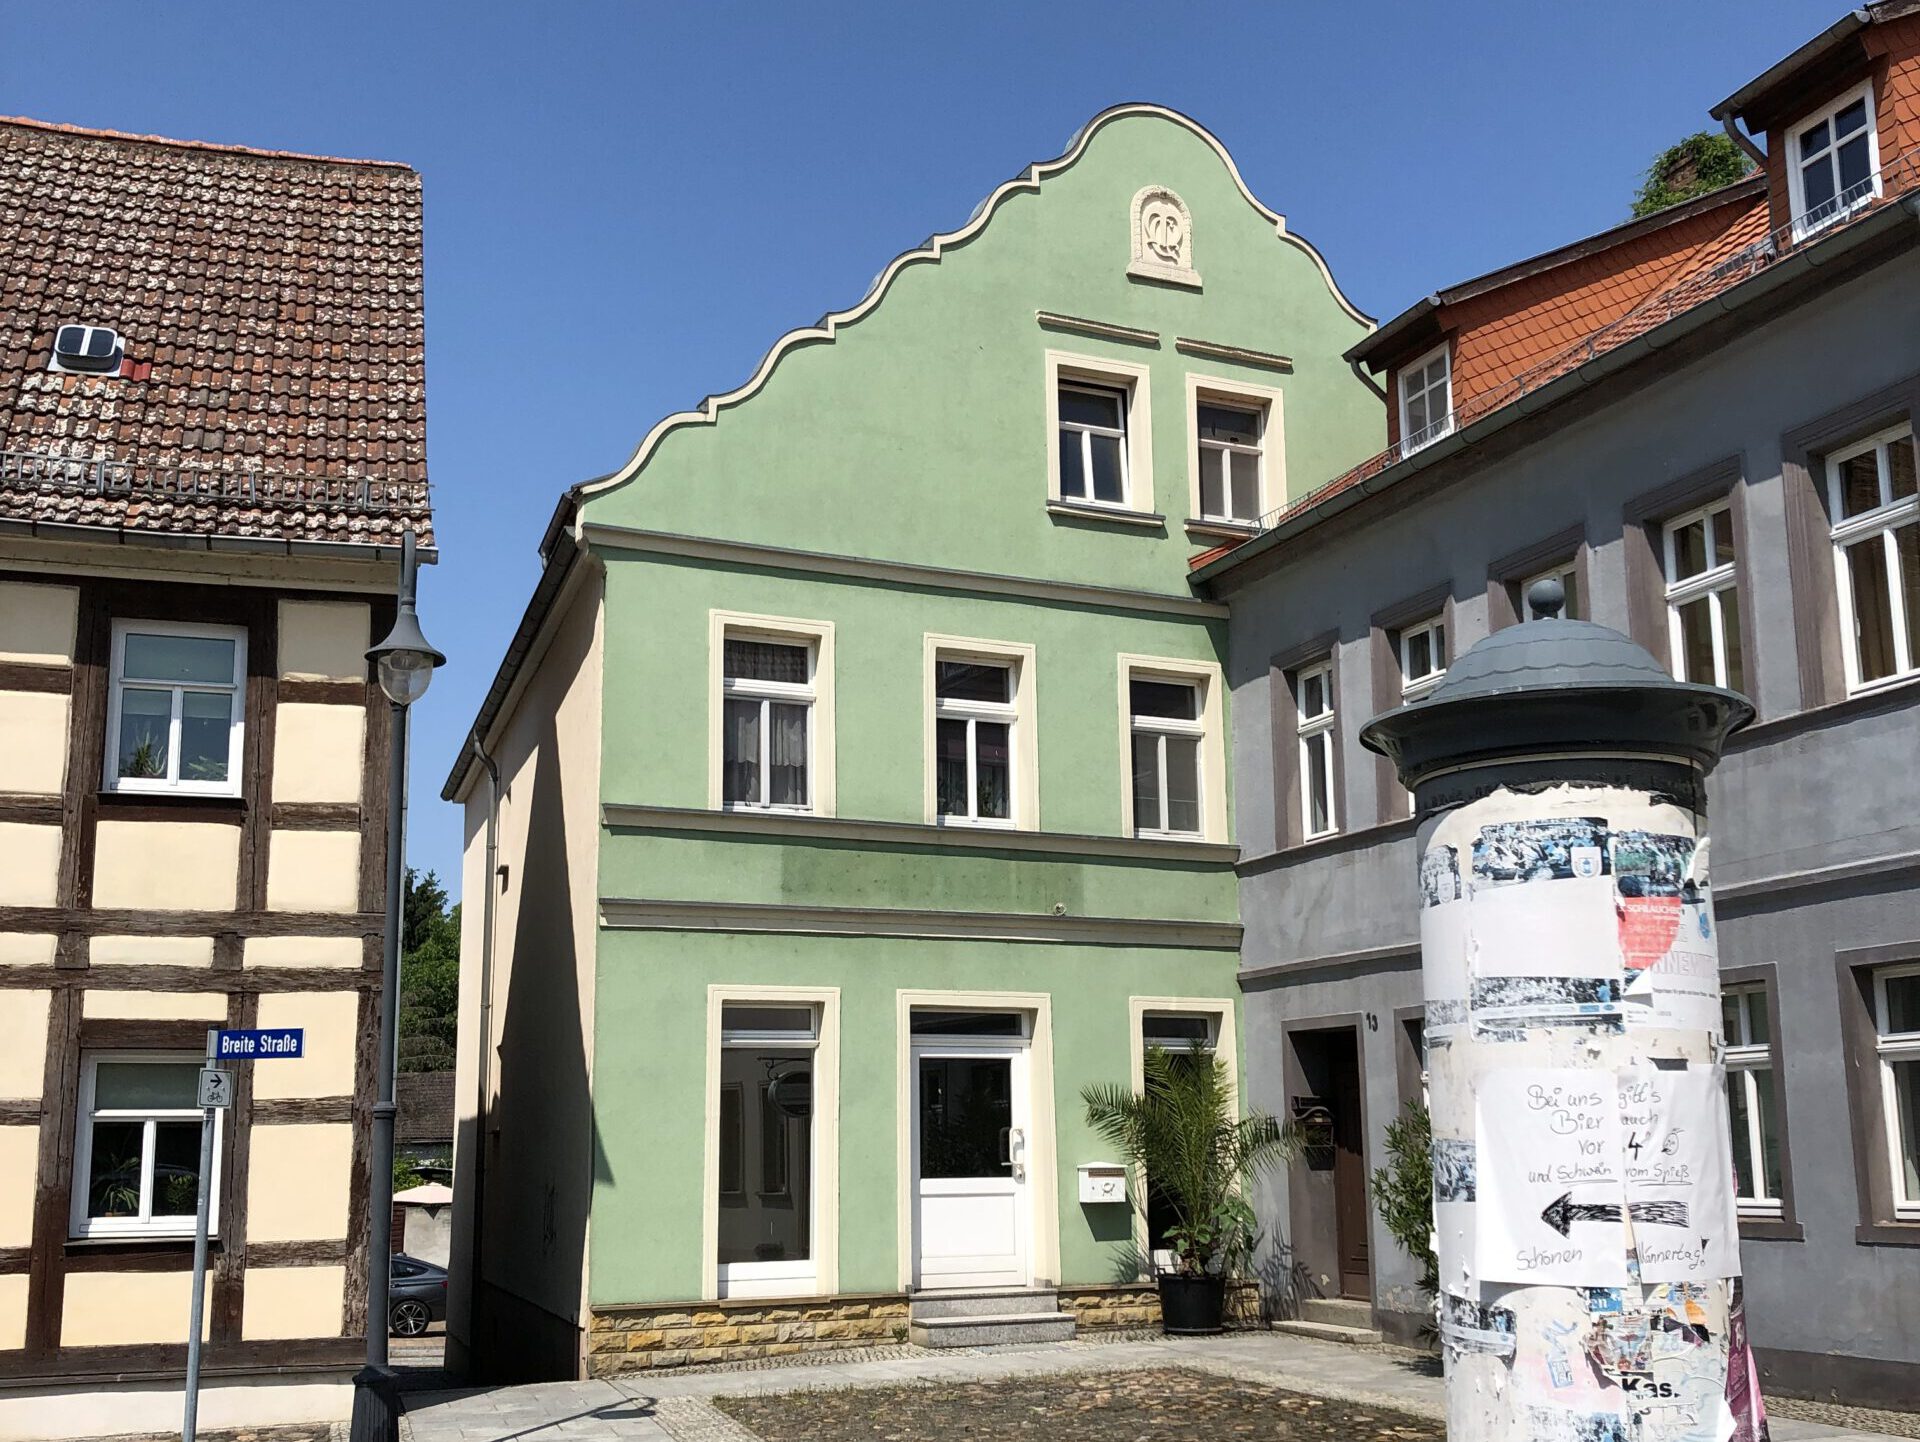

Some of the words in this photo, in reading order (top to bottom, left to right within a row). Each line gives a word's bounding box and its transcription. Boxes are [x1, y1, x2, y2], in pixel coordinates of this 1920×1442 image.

[1366, 1012, 1378, 1032] 13
[222, 1035, 255, 1053] Breite
[260, 1034, 297, 1053] Straße
[1527, 1084, 1562, 1110] Bei
[1567, 1092, 1603, 1107] uns
[1550, 1109, 1604, 1134] Bier
[1620, 1109, 1659, 1125] auch
[1528, 1165, 1552, 1183] und
[1557, 1162, 1612, 1180] Schwein
[1516, 1246, 1583, 1270] Schönen
